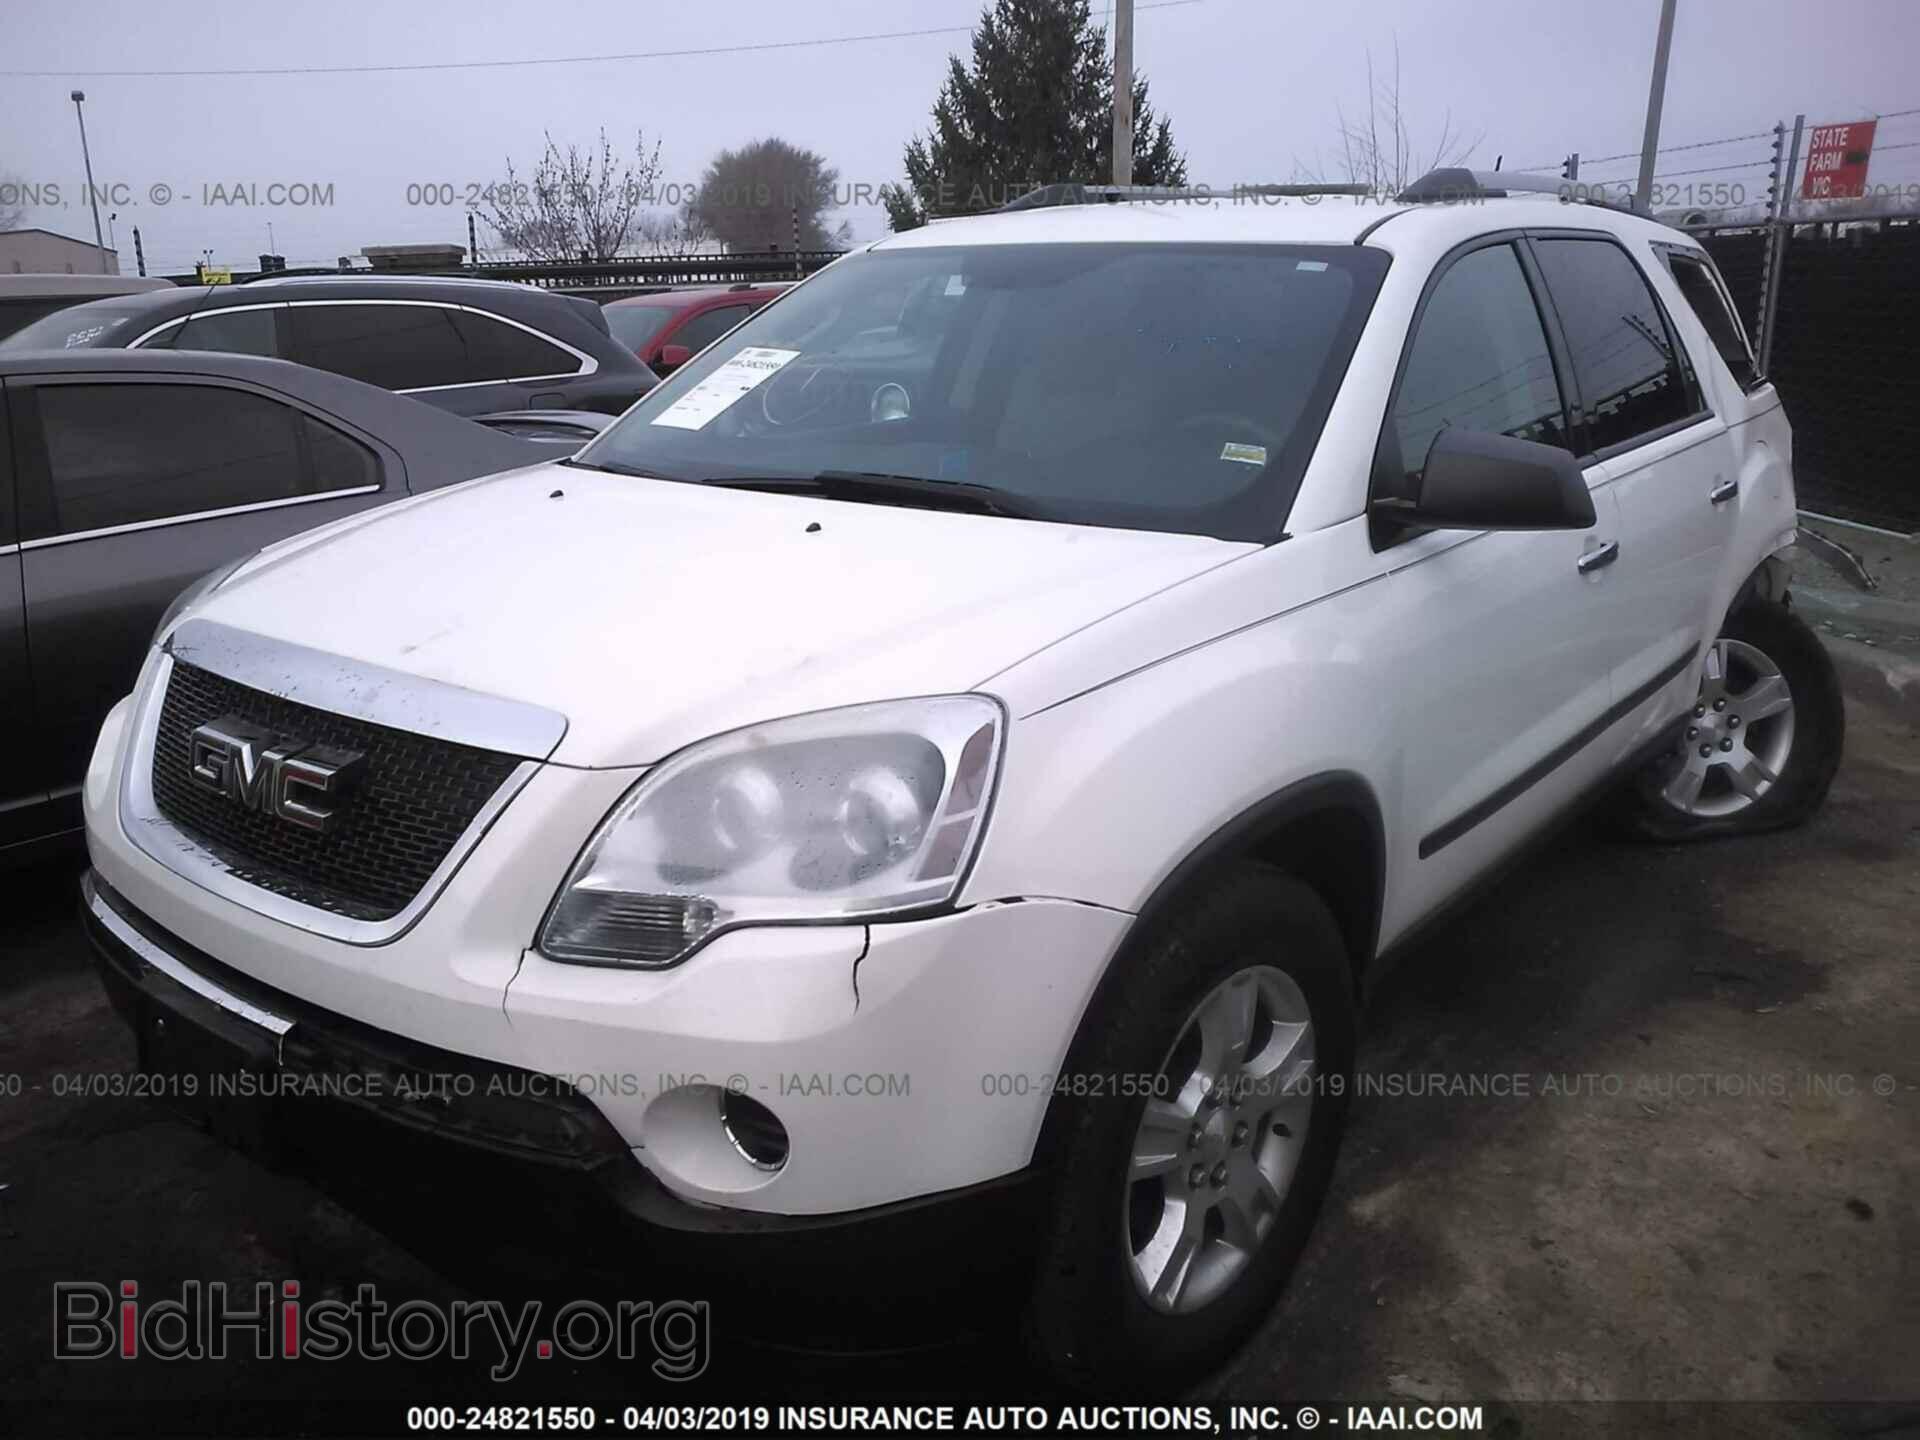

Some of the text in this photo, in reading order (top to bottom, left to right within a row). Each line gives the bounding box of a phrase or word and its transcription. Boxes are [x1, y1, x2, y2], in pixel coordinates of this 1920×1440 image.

[1812, 127, 1849, 149] STATE
[1809, 151, 1843, 172] FARM
[188, 722, 338, 831] GMC
